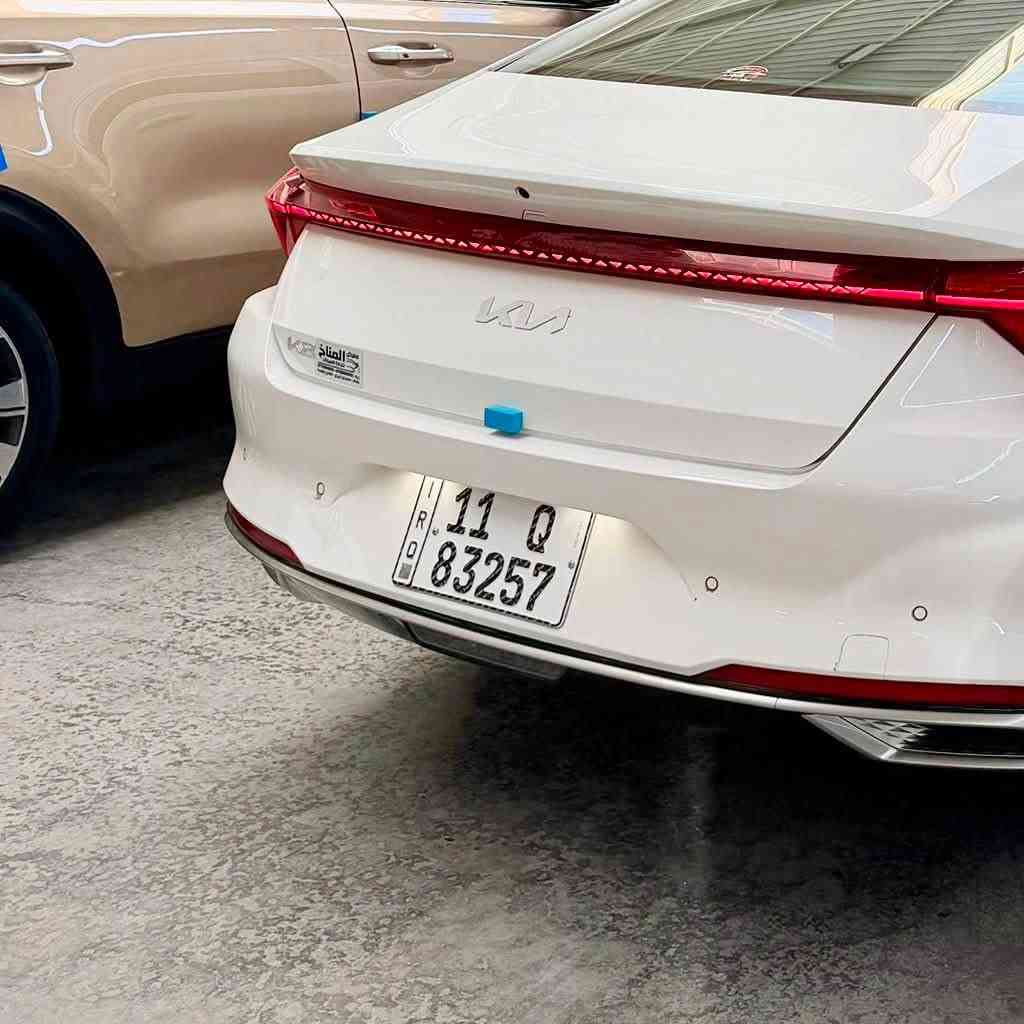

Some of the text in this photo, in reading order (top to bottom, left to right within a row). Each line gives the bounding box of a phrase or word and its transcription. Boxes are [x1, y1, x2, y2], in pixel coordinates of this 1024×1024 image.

[446, 487, 556, 554] 11 Q
[430, 540, 557, 612] 83257
